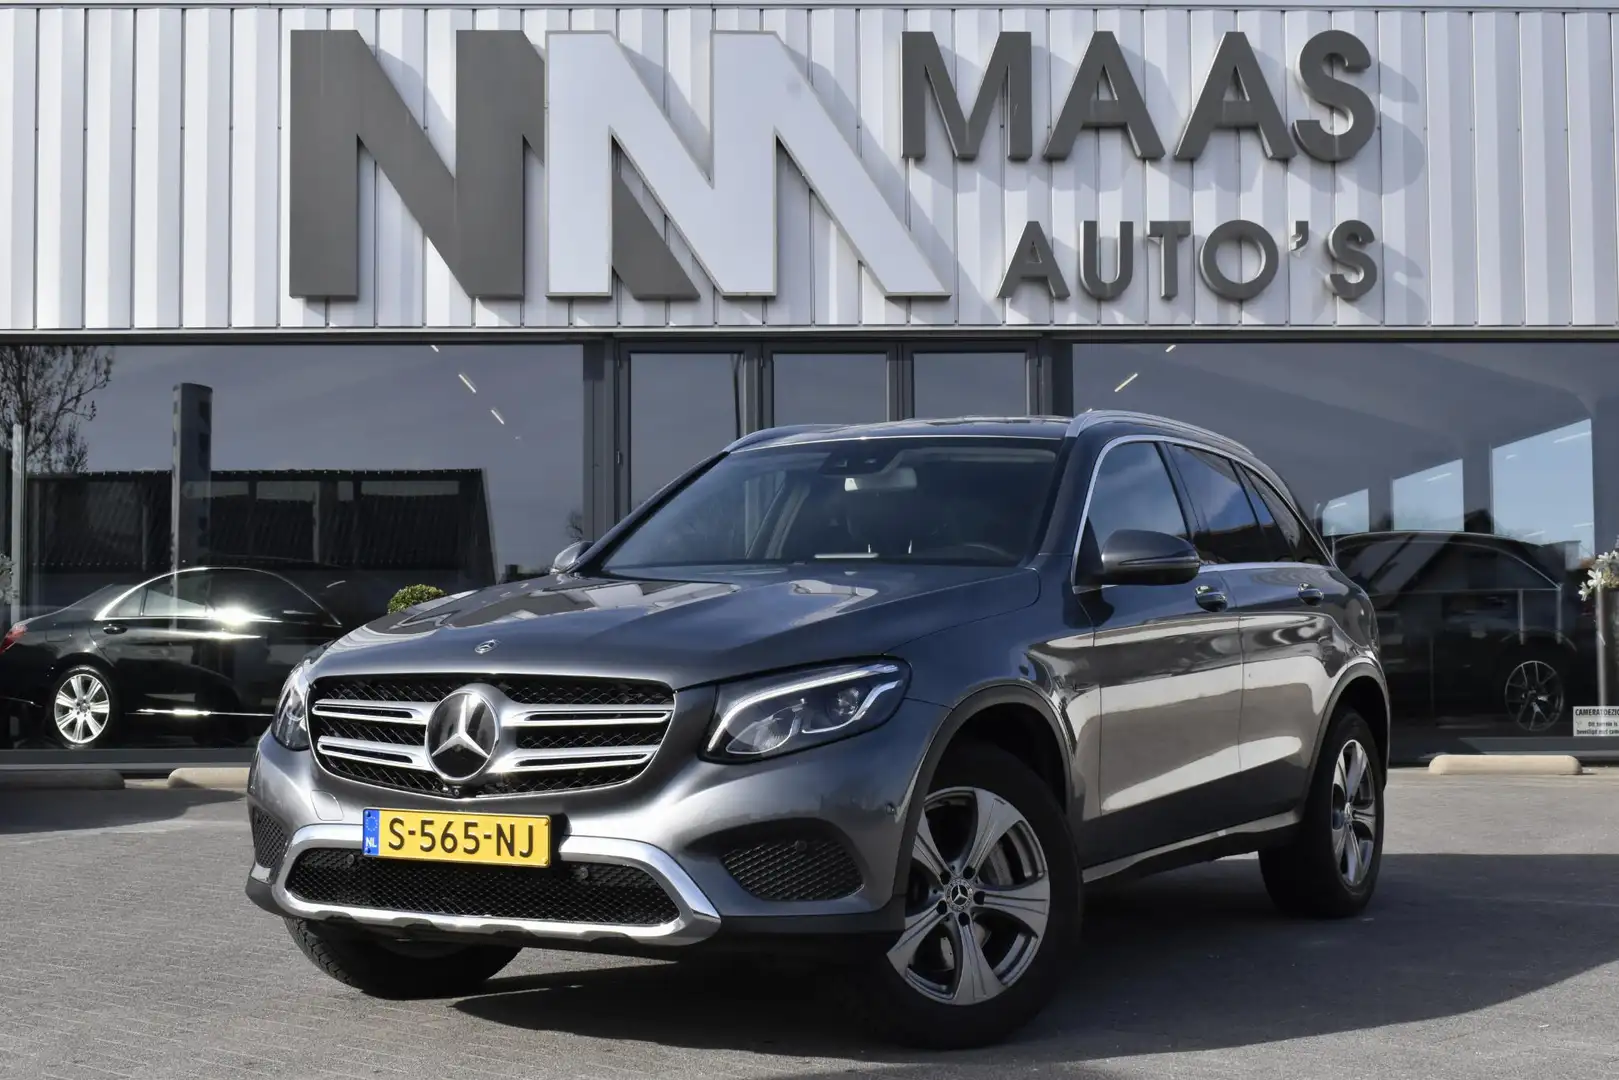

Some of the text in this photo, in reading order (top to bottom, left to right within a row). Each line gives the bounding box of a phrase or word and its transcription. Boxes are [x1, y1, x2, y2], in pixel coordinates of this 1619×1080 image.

[902, 30, 1376, 162] MAAS
[996, 219, 1377, 300] AUTO'S
[365, 836, 378, 848] NL
[388, 817, 534, 858] S-565-NJ
